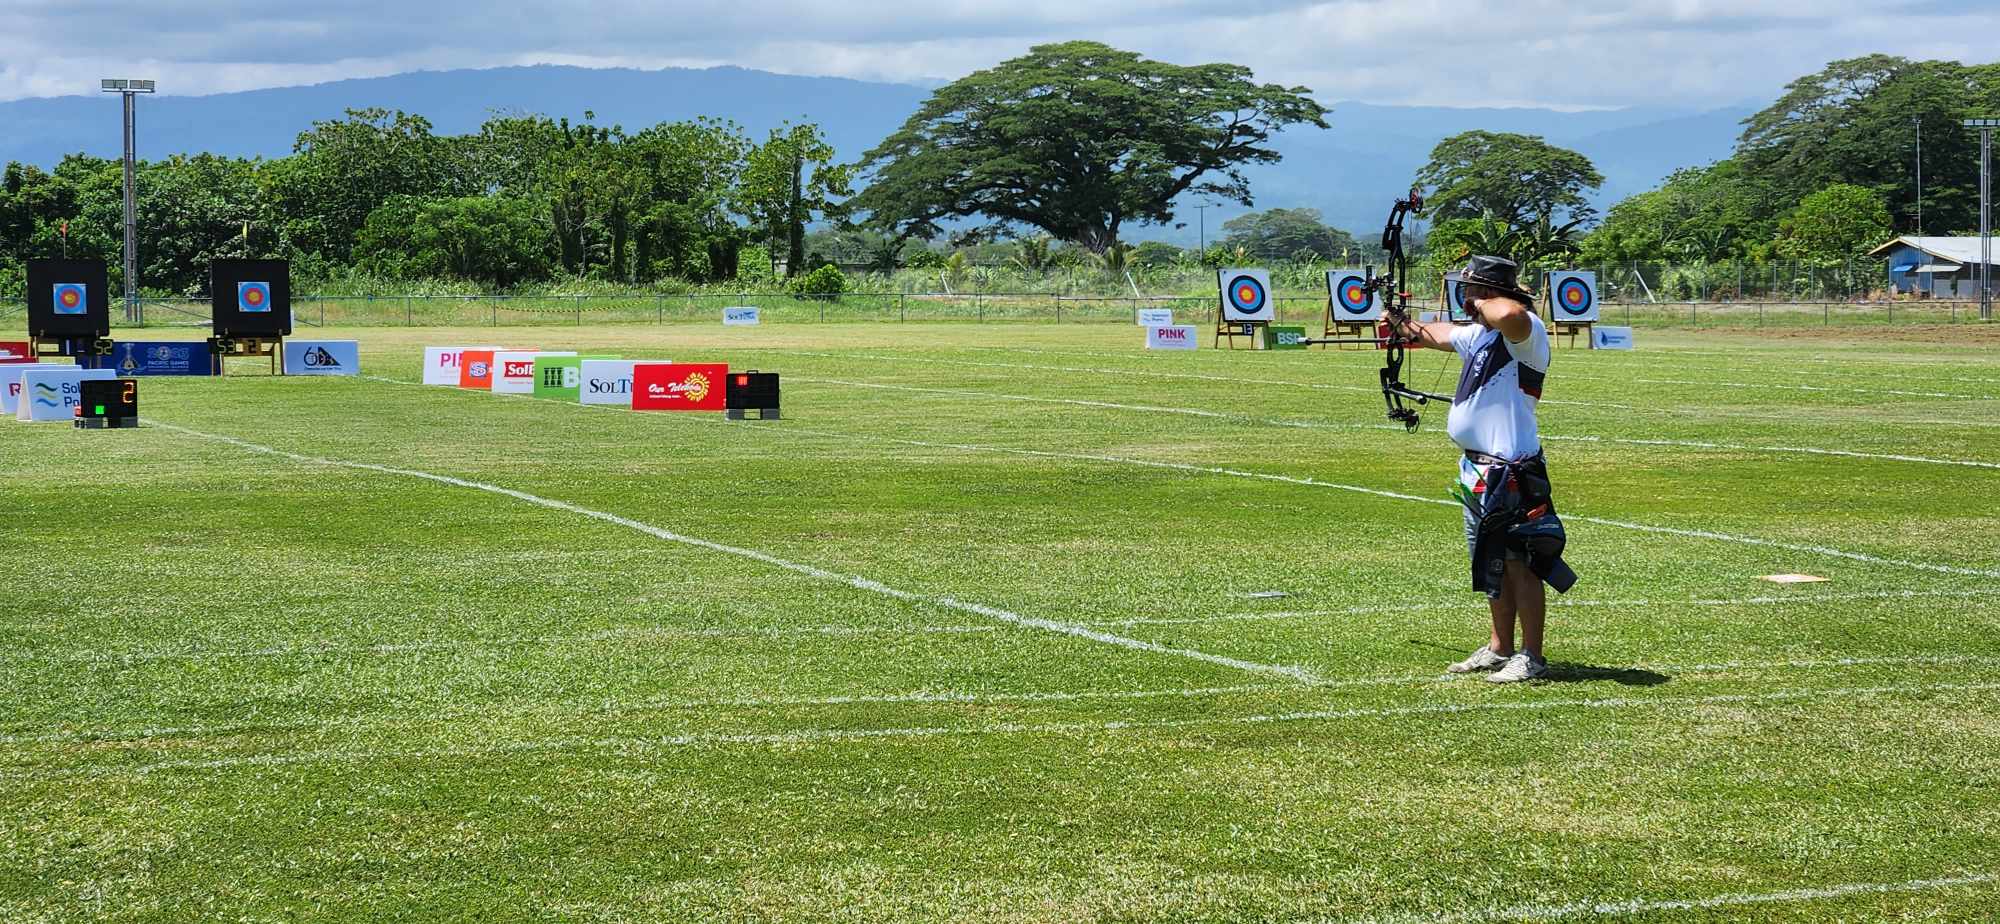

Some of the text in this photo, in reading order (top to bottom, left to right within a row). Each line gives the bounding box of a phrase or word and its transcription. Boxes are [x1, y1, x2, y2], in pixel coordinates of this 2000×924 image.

[1158, 329, 1185, 339] PINK
[1243, 324, 1253, 335] 13
[94, 340, 112, 355] 52
[217, 340, 236, 354] 53
[247, 340, 257, 354] 2
[122, 382, 134, 403] 2
[648, 383, 664, 393] Our
